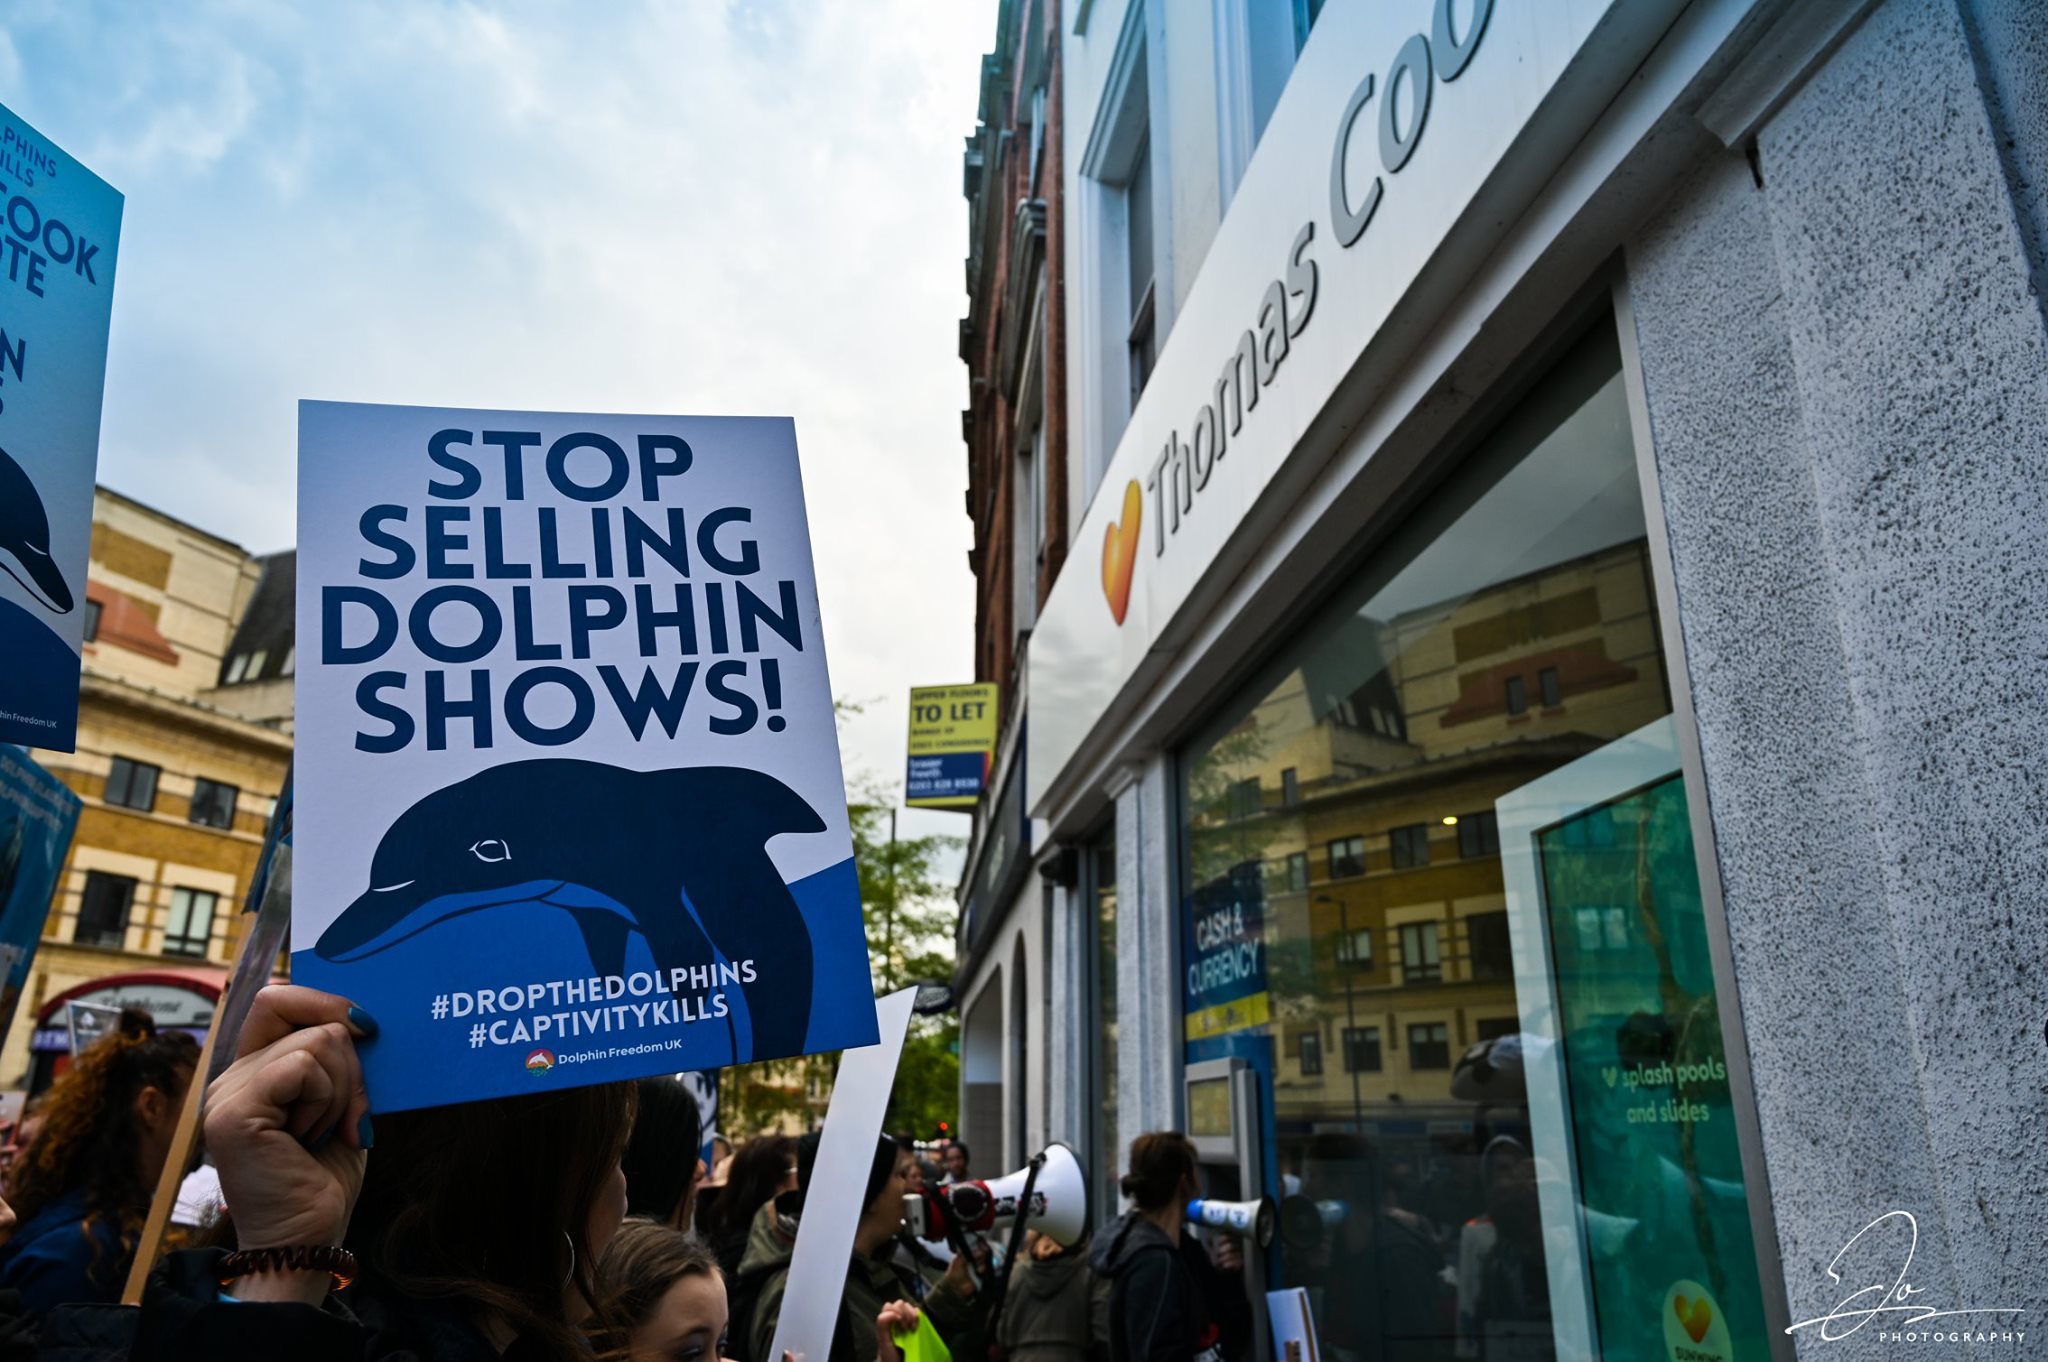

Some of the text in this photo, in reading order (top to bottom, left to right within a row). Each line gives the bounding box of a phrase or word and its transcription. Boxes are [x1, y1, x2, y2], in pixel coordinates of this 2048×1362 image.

[0, 126, 56, 178] PHINS
[0, 181, 99, 286] OOK
[0, 235, 47, 298] TE
[1147, 220, 1320, 558] Thomas
[427, 428, 693, 502] STOP
[358, 504, 760, 579] SELLING
[321, 580, 803, 665] DOLPHIN
[12, 713, 46, 728] Freedom
[46, 719, 57, 729] UK
[355, 658, 787, 753] SHOWS!
[913, 701, 987, 723] TO LET
[1196, 901, 1244, 952] CASH &
[431, 959, 757, 1020] #DROPTHEDOLPHINS
[1187, 937, 1260, 996] CURRENCY
[469, 994, 729, 1049] #CAPTIVITYKILLS
[558, 1038, 682, 1065] Dolphin Freedom UK
[1622, 1055, 1726, 1094] splash pools
[1626, 1098, 1710, 1124] and slides
